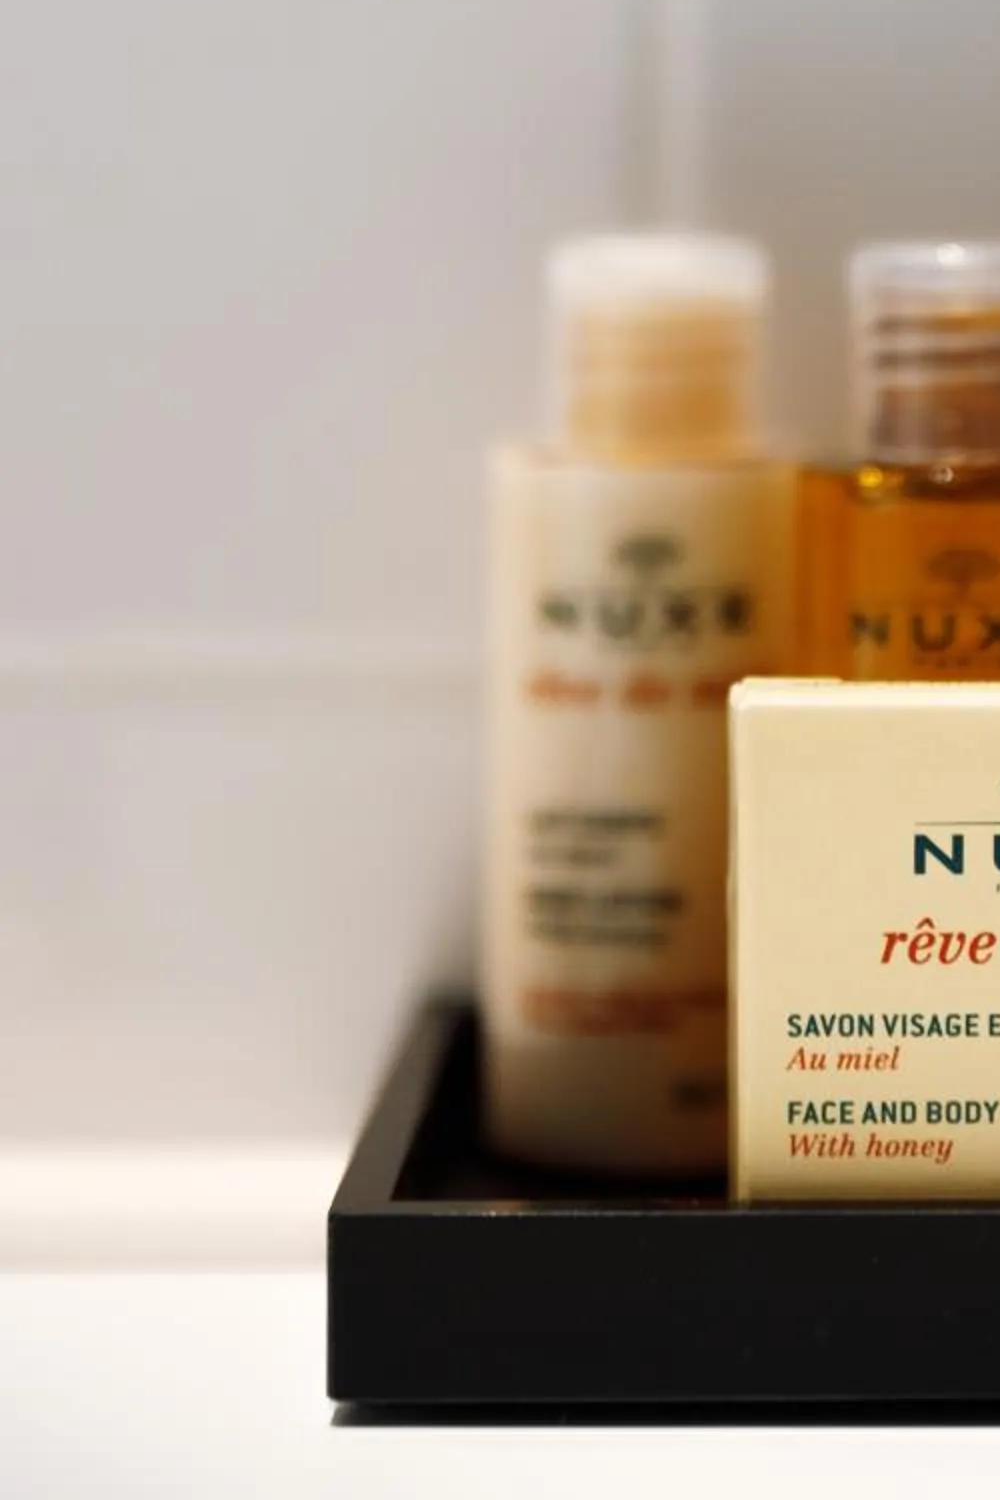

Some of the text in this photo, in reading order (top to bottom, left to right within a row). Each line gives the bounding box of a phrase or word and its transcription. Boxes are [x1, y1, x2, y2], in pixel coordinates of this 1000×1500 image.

[881, 917, 997, 964] rêve
[787, 1013, 874, 1037] SAVON
[882, 1013, 979, 1037] VISAGE
[787, 1045, 900, 1071] Au miel
[788, 1101, 854, 1124] FACE
[861, 1101, 917, 1124] AND
[926, 1101, 999, 1124] BODY
[789, 1133, 954, 1164] With honey
